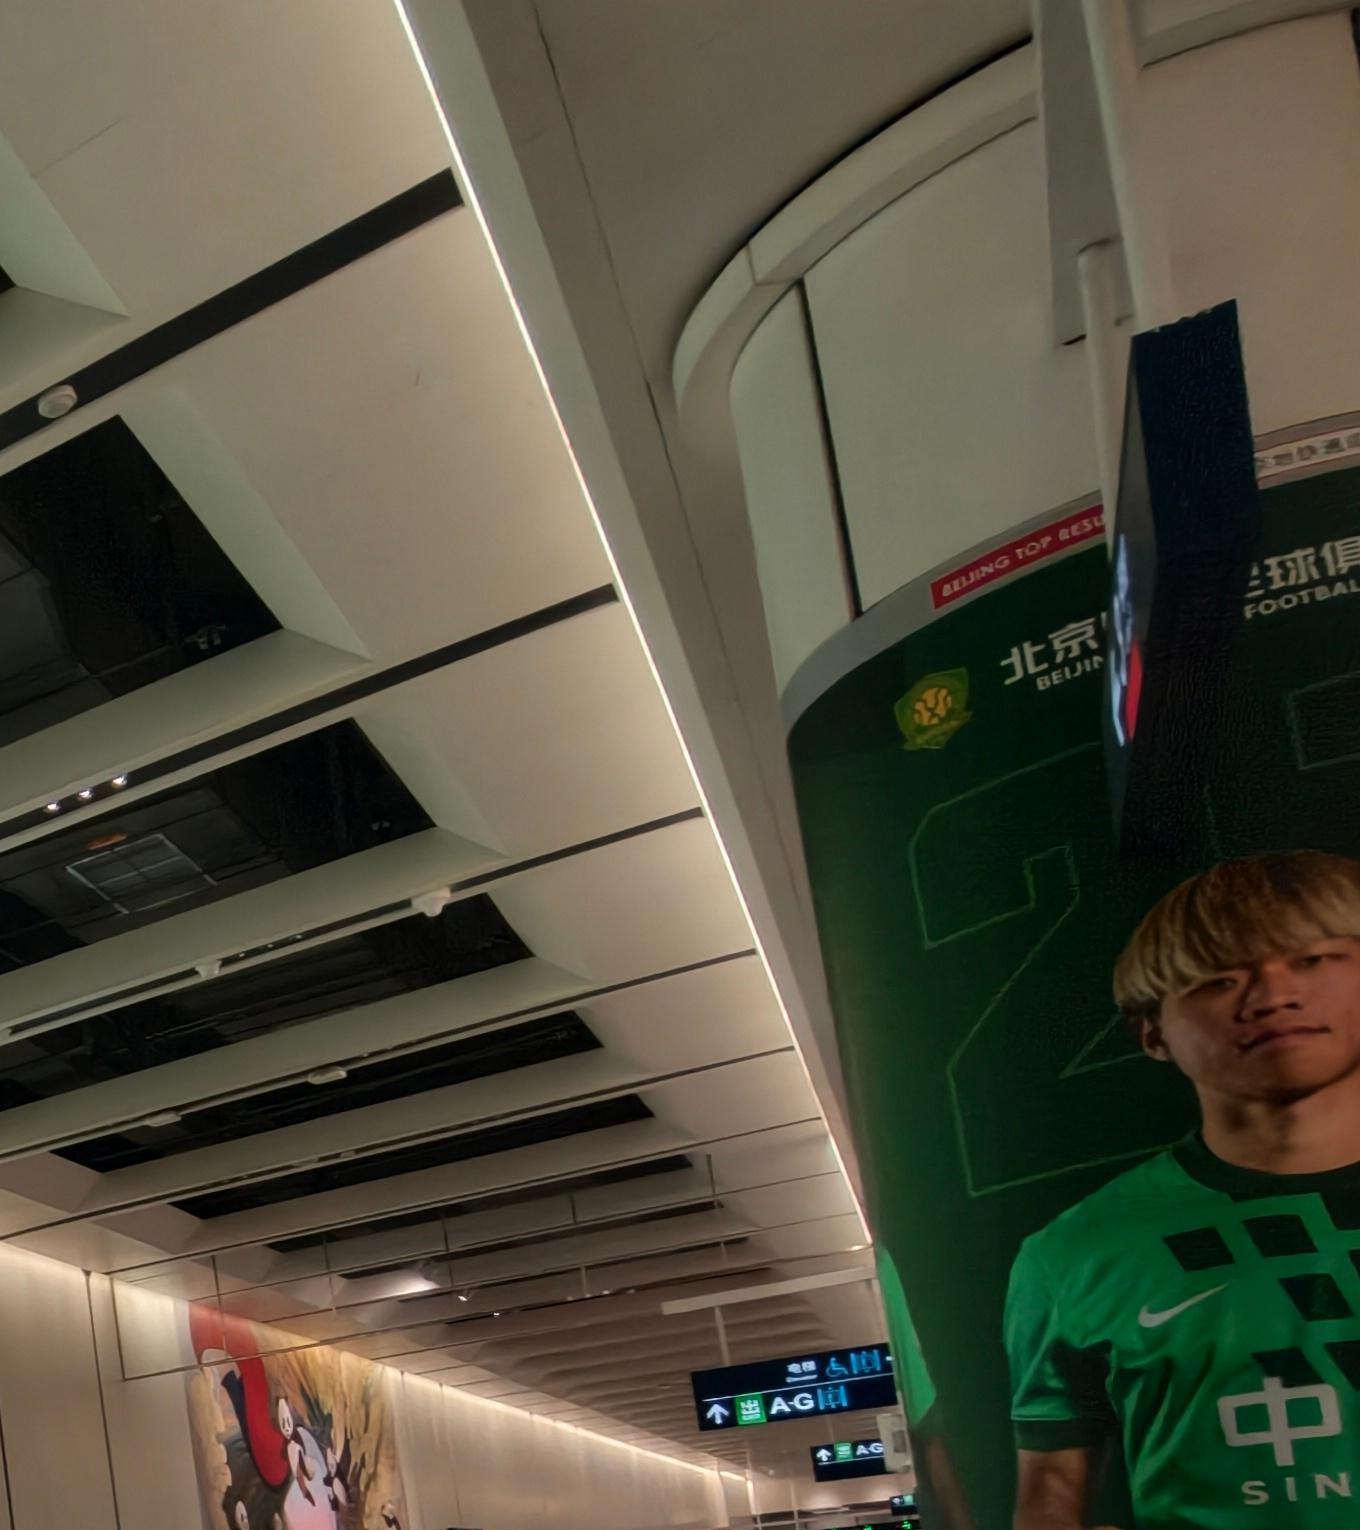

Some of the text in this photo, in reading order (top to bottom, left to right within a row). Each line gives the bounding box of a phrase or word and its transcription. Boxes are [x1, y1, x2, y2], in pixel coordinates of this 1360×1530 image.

[942, 556, 1011, 597] BEIJING
[1016, 536, 1053, 560] TOP
[1000, 616, 1107, 685] 北京
[1217, 1376, 1342, 1467] 中
[1241, 1472, 1352, 1506] SIN
